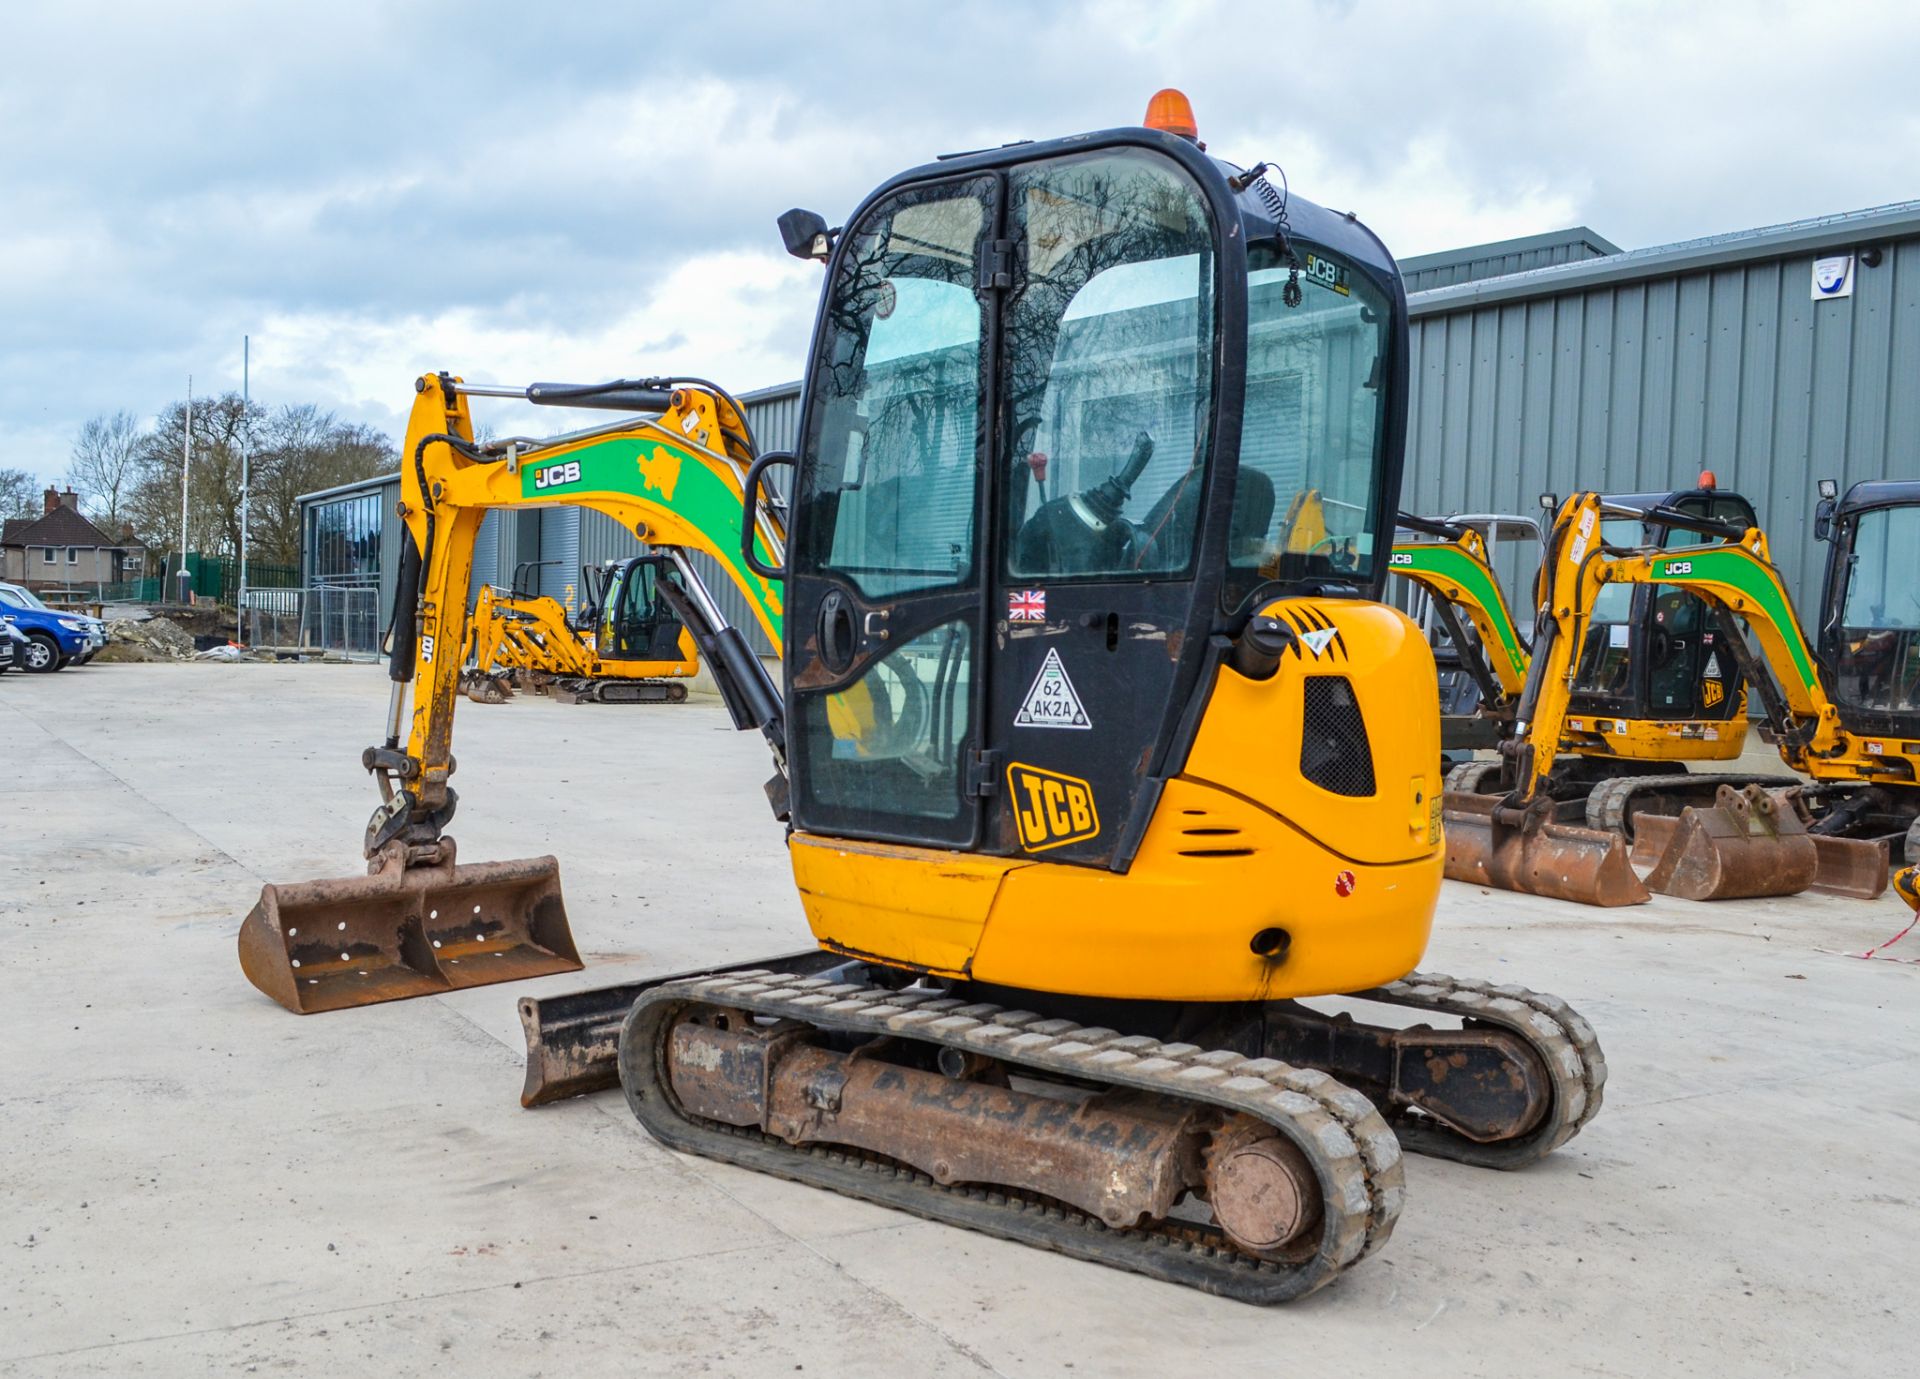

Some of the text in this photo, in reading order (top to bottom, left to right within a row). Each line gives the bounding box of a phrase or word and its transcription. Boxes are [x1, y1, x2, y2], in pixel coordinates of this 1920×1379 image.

[1307, 255, 1336, 283] JCB
[535, 462, 581, 488] JCB
[1665, 562, 1692, 574] JCB
[1043, 681, 1062, 696] 62
[1034, 700, 1072, 718] AK2A
[1021, 773, 1092, 843] JCB
